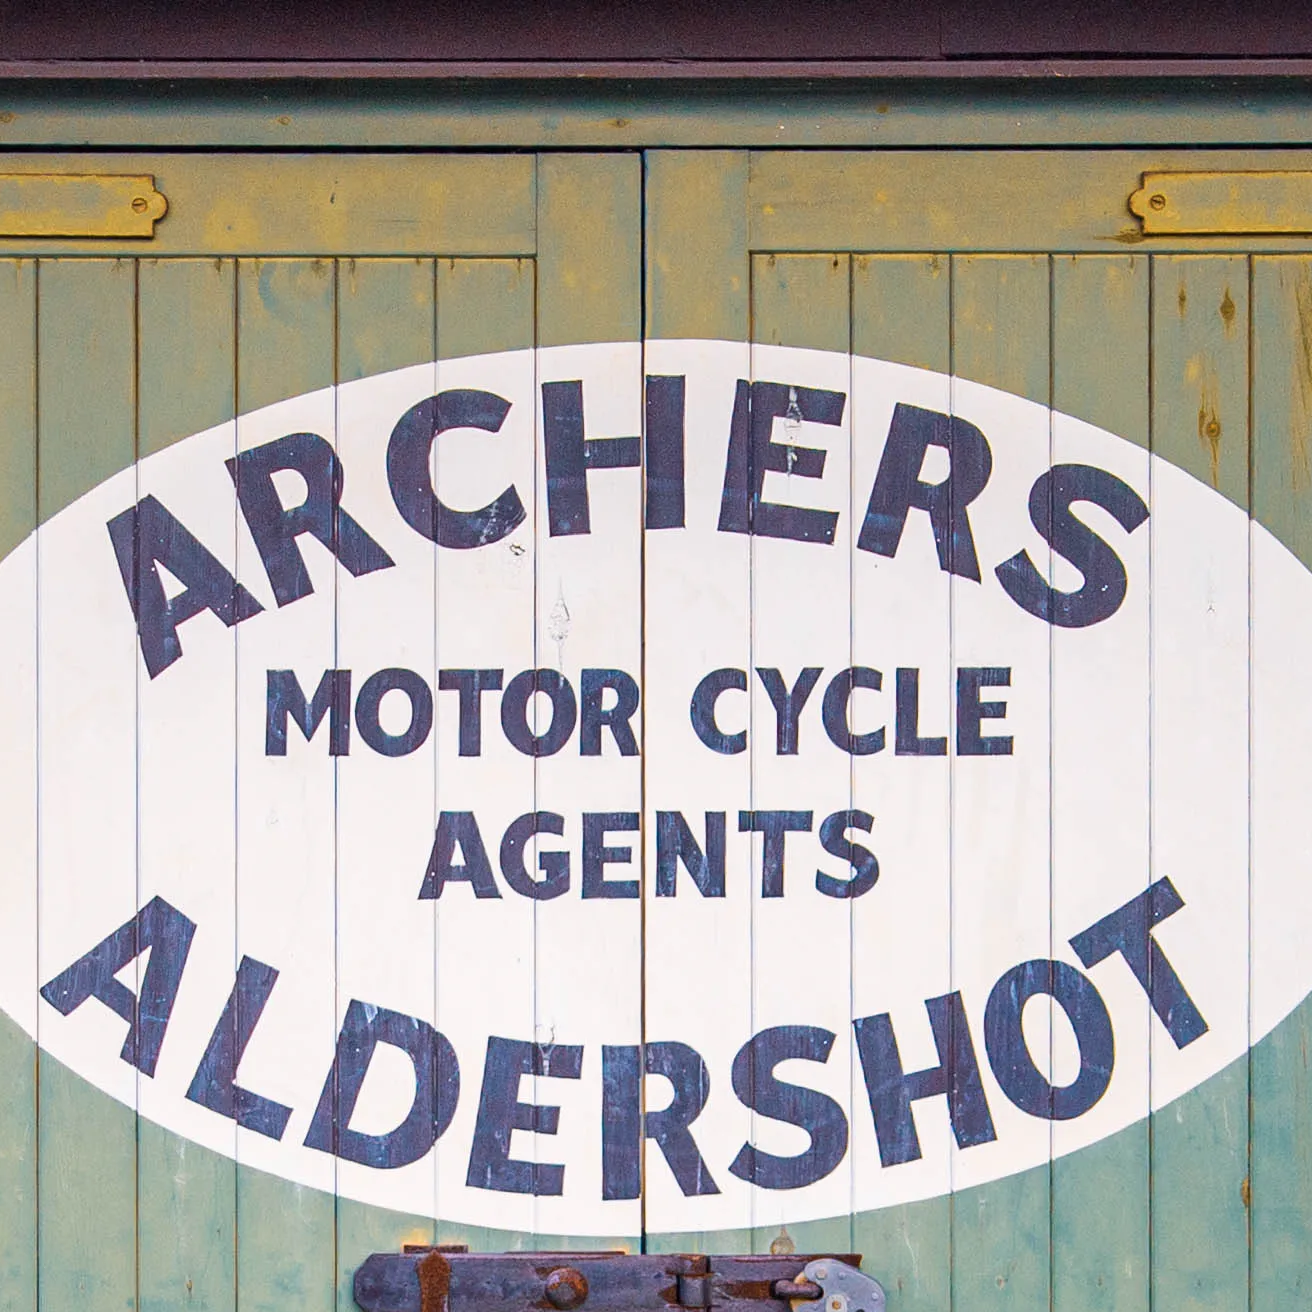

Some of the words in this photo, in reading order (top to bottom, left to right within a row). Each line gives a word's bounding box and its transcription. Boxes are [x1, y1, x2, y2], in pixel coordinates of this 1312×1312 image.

[105, 374, 1151, 679] ARCHERS
[264, 667, 641, 758] MOTOR
[689, 666, 1015, 757] CYCLE
[418, 810, 880, 900] AGENTS
[38, 876, 1210, 1202] ALDERSHOT
